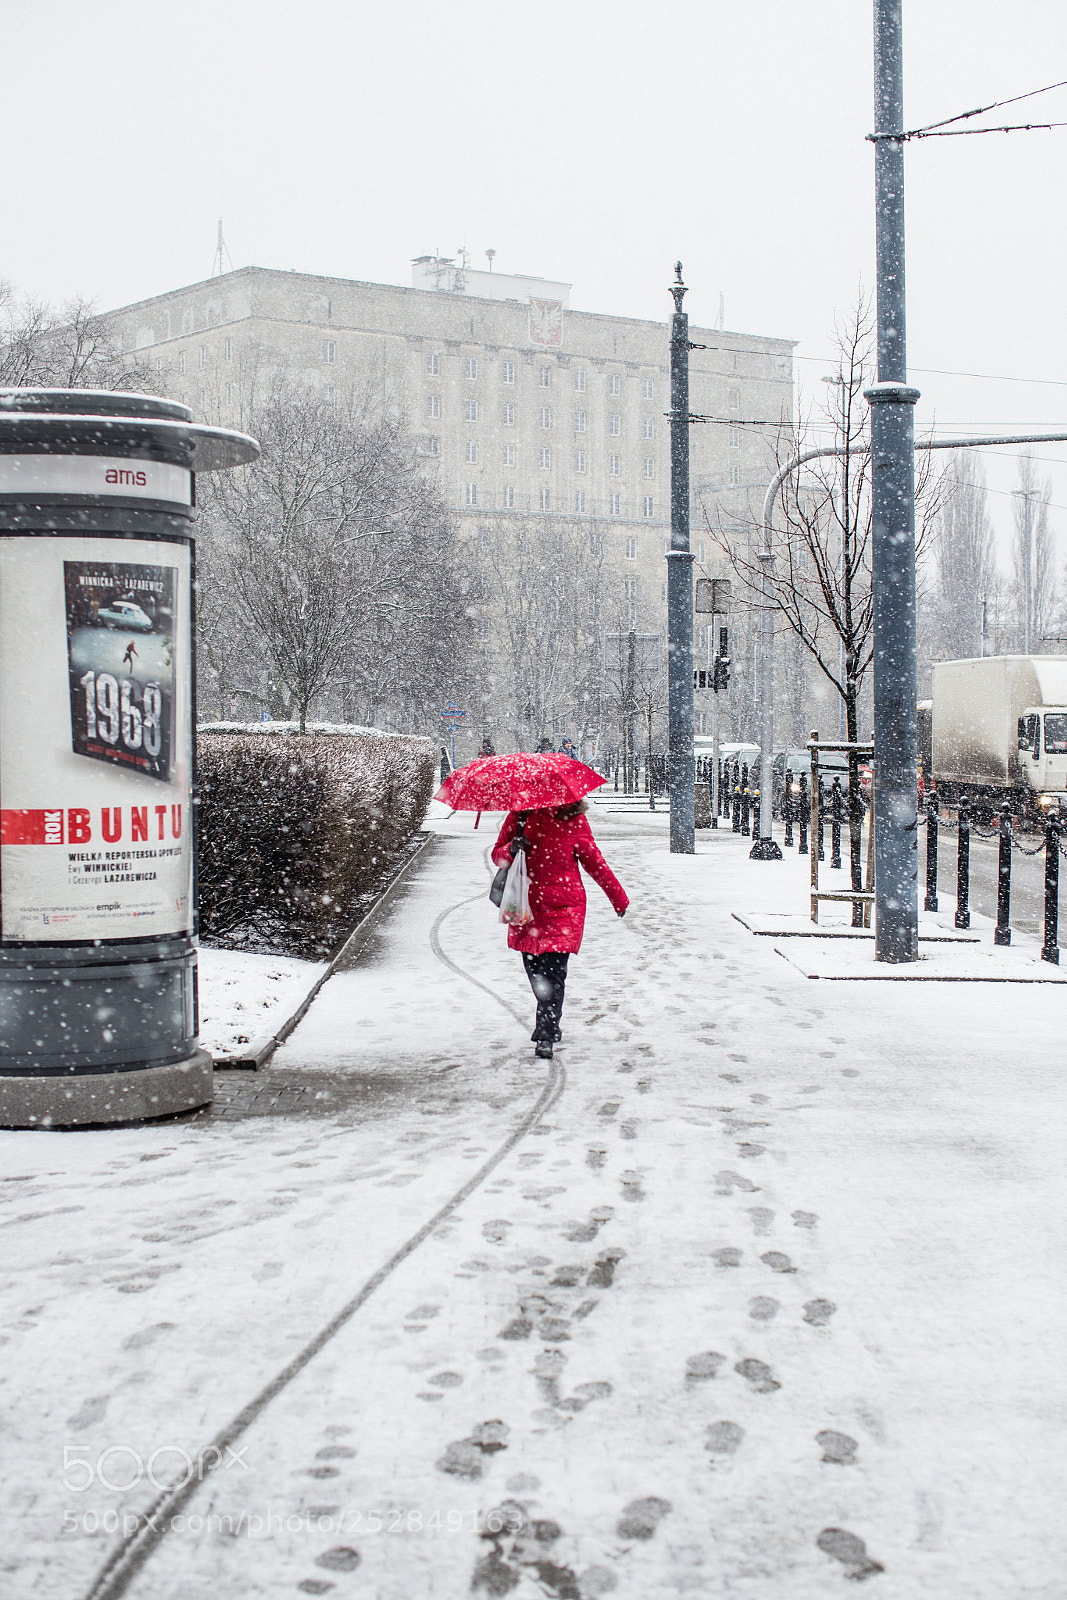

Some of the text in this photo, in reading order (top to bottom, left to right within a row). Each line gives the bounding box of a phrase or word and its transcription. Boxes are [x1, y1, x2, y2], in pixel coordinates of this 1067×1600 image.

[105, 468, 147, 487] ams
[80, 670, 162, 757] 1968
[44, 811, 61, 844] ROK
[67, 803, 182, 844] BUNTU
[68, 852, 102, 862] WIELKA
[105, 849, 157, 861] REPORTERSKA
[68, 862, 132, 874] Ewy WINNICKIEJ
[104, 871, 157, 883] ŁAZAREWICZA
[96, 901, 122, 911] empik
